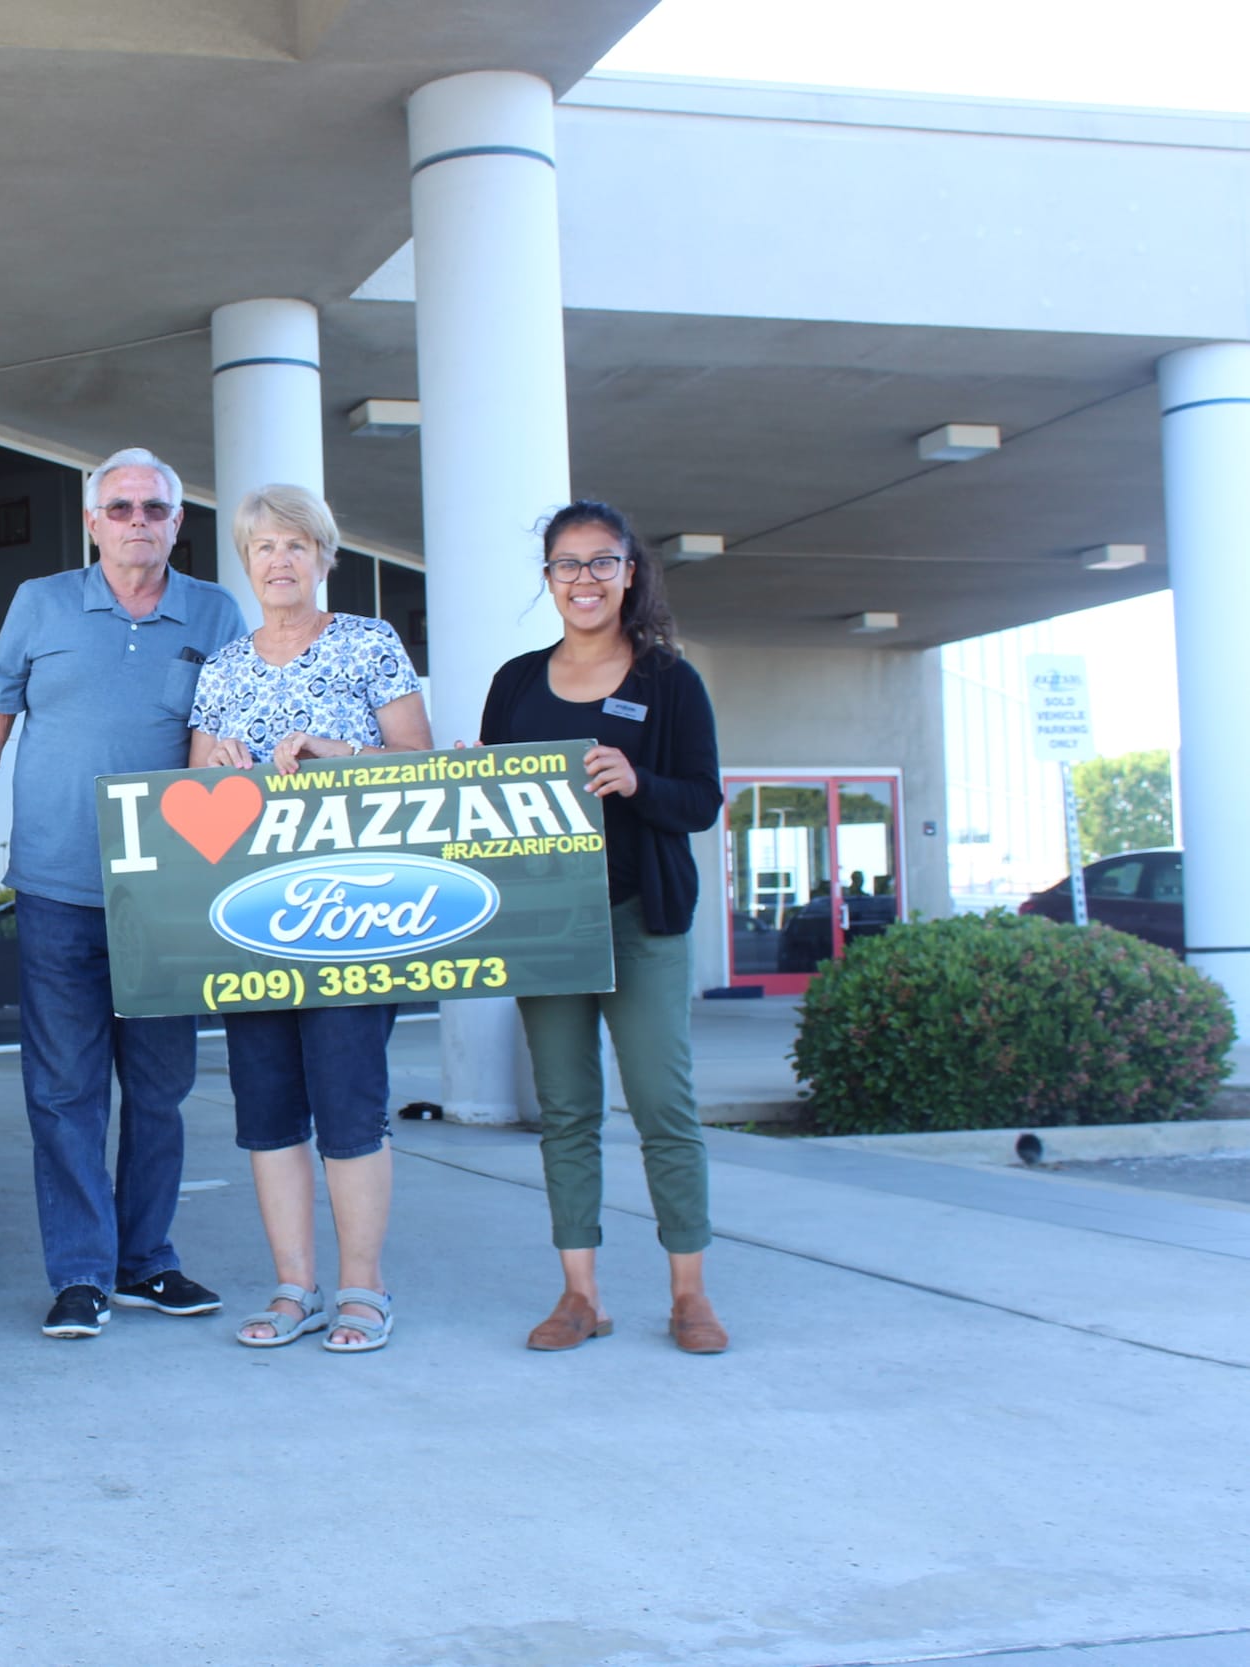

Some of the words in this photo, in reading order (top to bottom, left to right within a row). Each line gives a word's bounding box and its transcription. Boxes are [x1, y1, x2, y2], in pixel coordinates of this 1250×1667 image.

[1044, 697, 1075, 706] SOLD
[1037, 711, 1085, 721] VEHICLE
[1037, 725, 1088, 735] PARKING
[1049, 739, 1078, 749] ONLY
[265, 753, 567, 793] www.razzariford.com
[107, 782, 157, 873] I
[248, 780, 597, 855] RAZZARI
[441, 834, 603, 861] #RAZZARIFORD
[268, 872, 439, 942] Ford
[202, 968, 305, 1011] (209)
[318, 957, 507, 996] 383-3673
